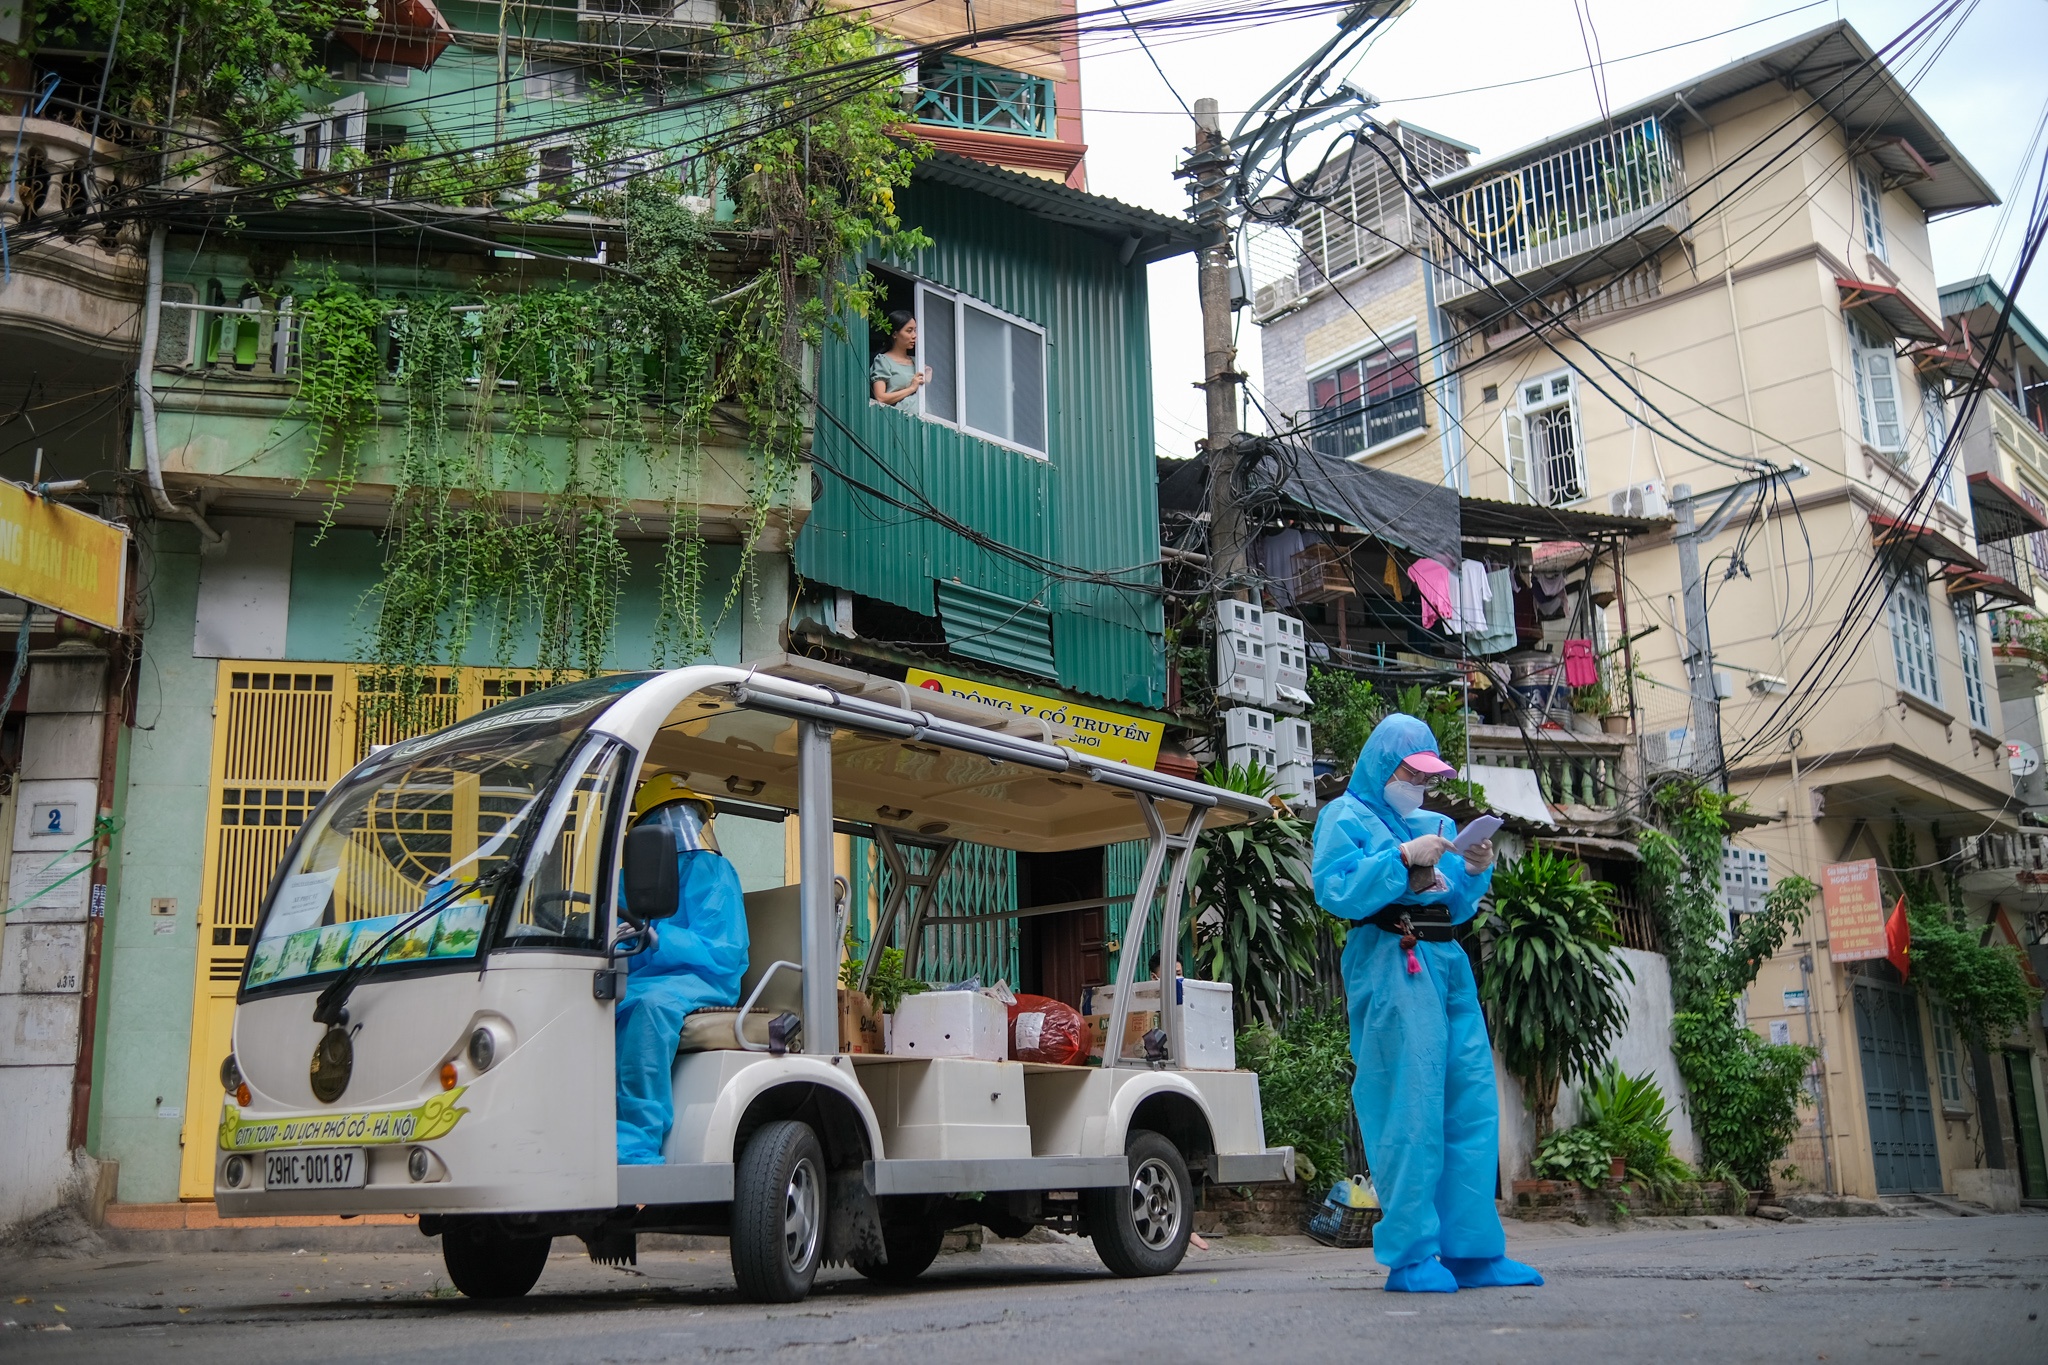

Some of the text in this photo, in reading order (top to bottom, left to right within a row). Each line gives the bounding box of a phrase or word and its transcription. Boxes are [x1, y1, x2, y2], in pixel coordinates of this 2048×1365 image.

[1039, 706, 1068, 724] CỔ
[1072, 716, 1151, 743] TRUYỀN
[48, 808, 62, 829] 2
[235, 1126, 255, 1146] CITY
[254, 1124, 279, 1143] TOUR
[282, 1123, 299, 1141] DU
[297, 1121, 323, 1145] LỊCH
[322, 1114, 352, 1138] PHỐ
[372, 1112, 391, 1137] HÀ
[392, 1112, 416, 1142] NỘI
[268, 1152, 354, 1186] 29HC-001.87
